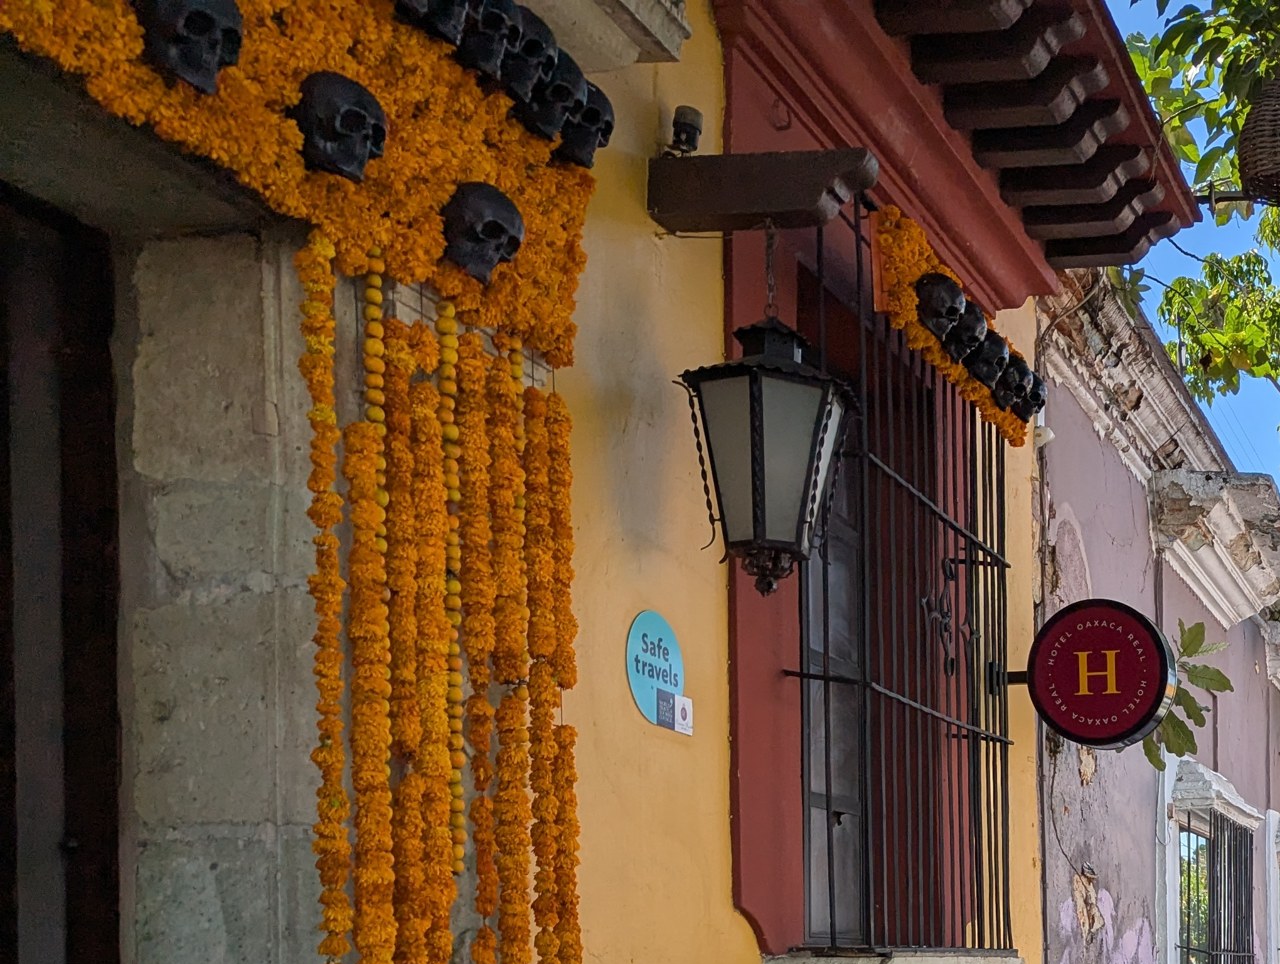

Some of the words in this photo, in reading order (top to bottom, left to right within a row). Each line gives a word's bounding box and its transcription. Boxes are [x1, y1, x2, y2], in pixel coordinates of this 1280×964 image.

[641, 632, 670, 663] Safe
[1048, 632, 1072, 665] HOTEL
[1077, 620, 1123, 633] OAXACA
[1127, 633, 1146, 662] REAL
[634, 654, 679, 688] travels
[1073, 649, 1122, 696] H
[1049, 683, 1067, 711] REAL
[1122, 680, 1147, 714] HOTEL
[1072, 712, 1118, 725] OAXACA
